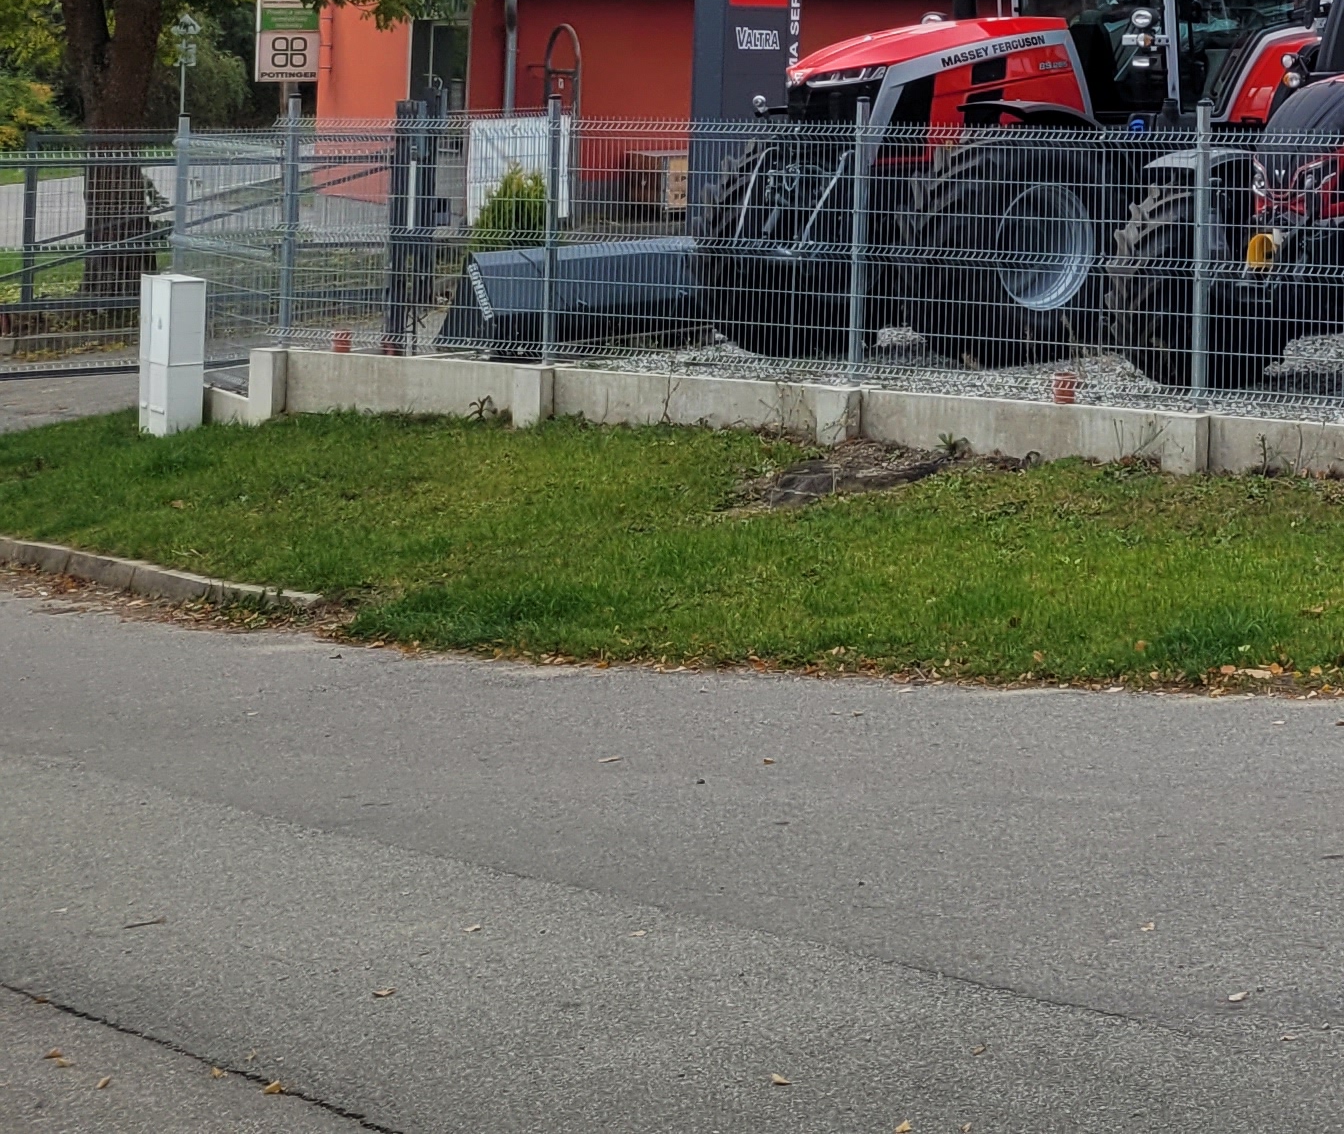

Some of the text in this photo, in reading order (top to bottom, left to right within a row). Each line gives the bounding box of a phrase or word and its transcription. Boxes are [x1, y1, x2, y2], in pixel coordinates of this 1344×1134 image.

[736, 27, 780, 50] VALTRA
[941, 35, 1046, 68] MASSEY FERGUSON
